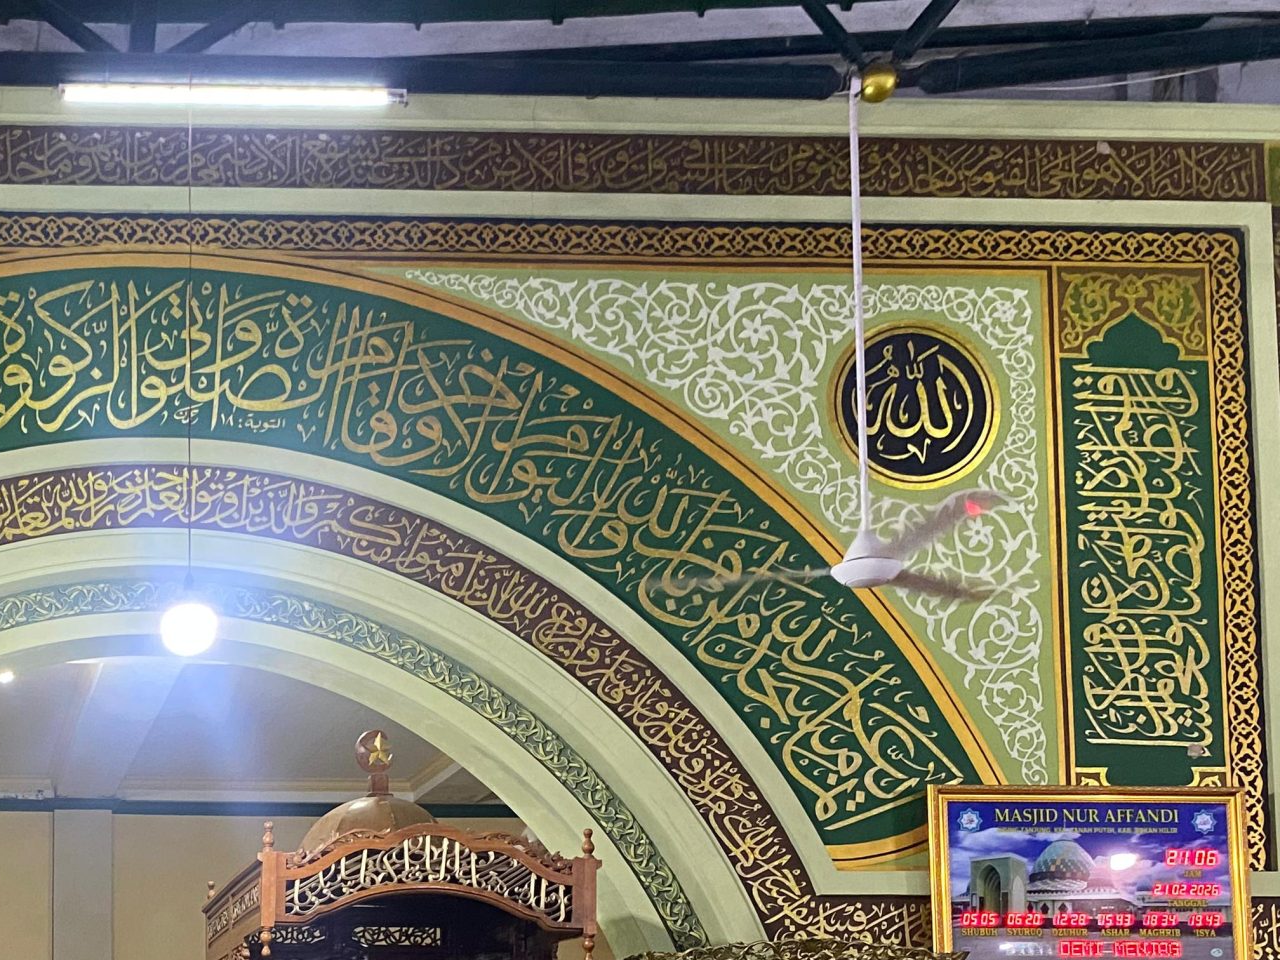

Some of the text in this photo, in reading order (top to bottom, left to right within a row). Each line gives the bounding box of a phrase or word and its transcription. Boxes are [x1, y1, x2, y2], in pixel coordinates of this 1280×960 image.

[995, 808, 1180, 825] MASJID NUR AFFANDI
[961, 928, 999, 936] SHUBUH
[1006, 928, 1044, 937] SYURUQ
[1100, 928, 1131, 937] ASHAR
[1139, 928, 1181, 937] MAGHRIB
[1059, 940, 1104, 957] DEMI
